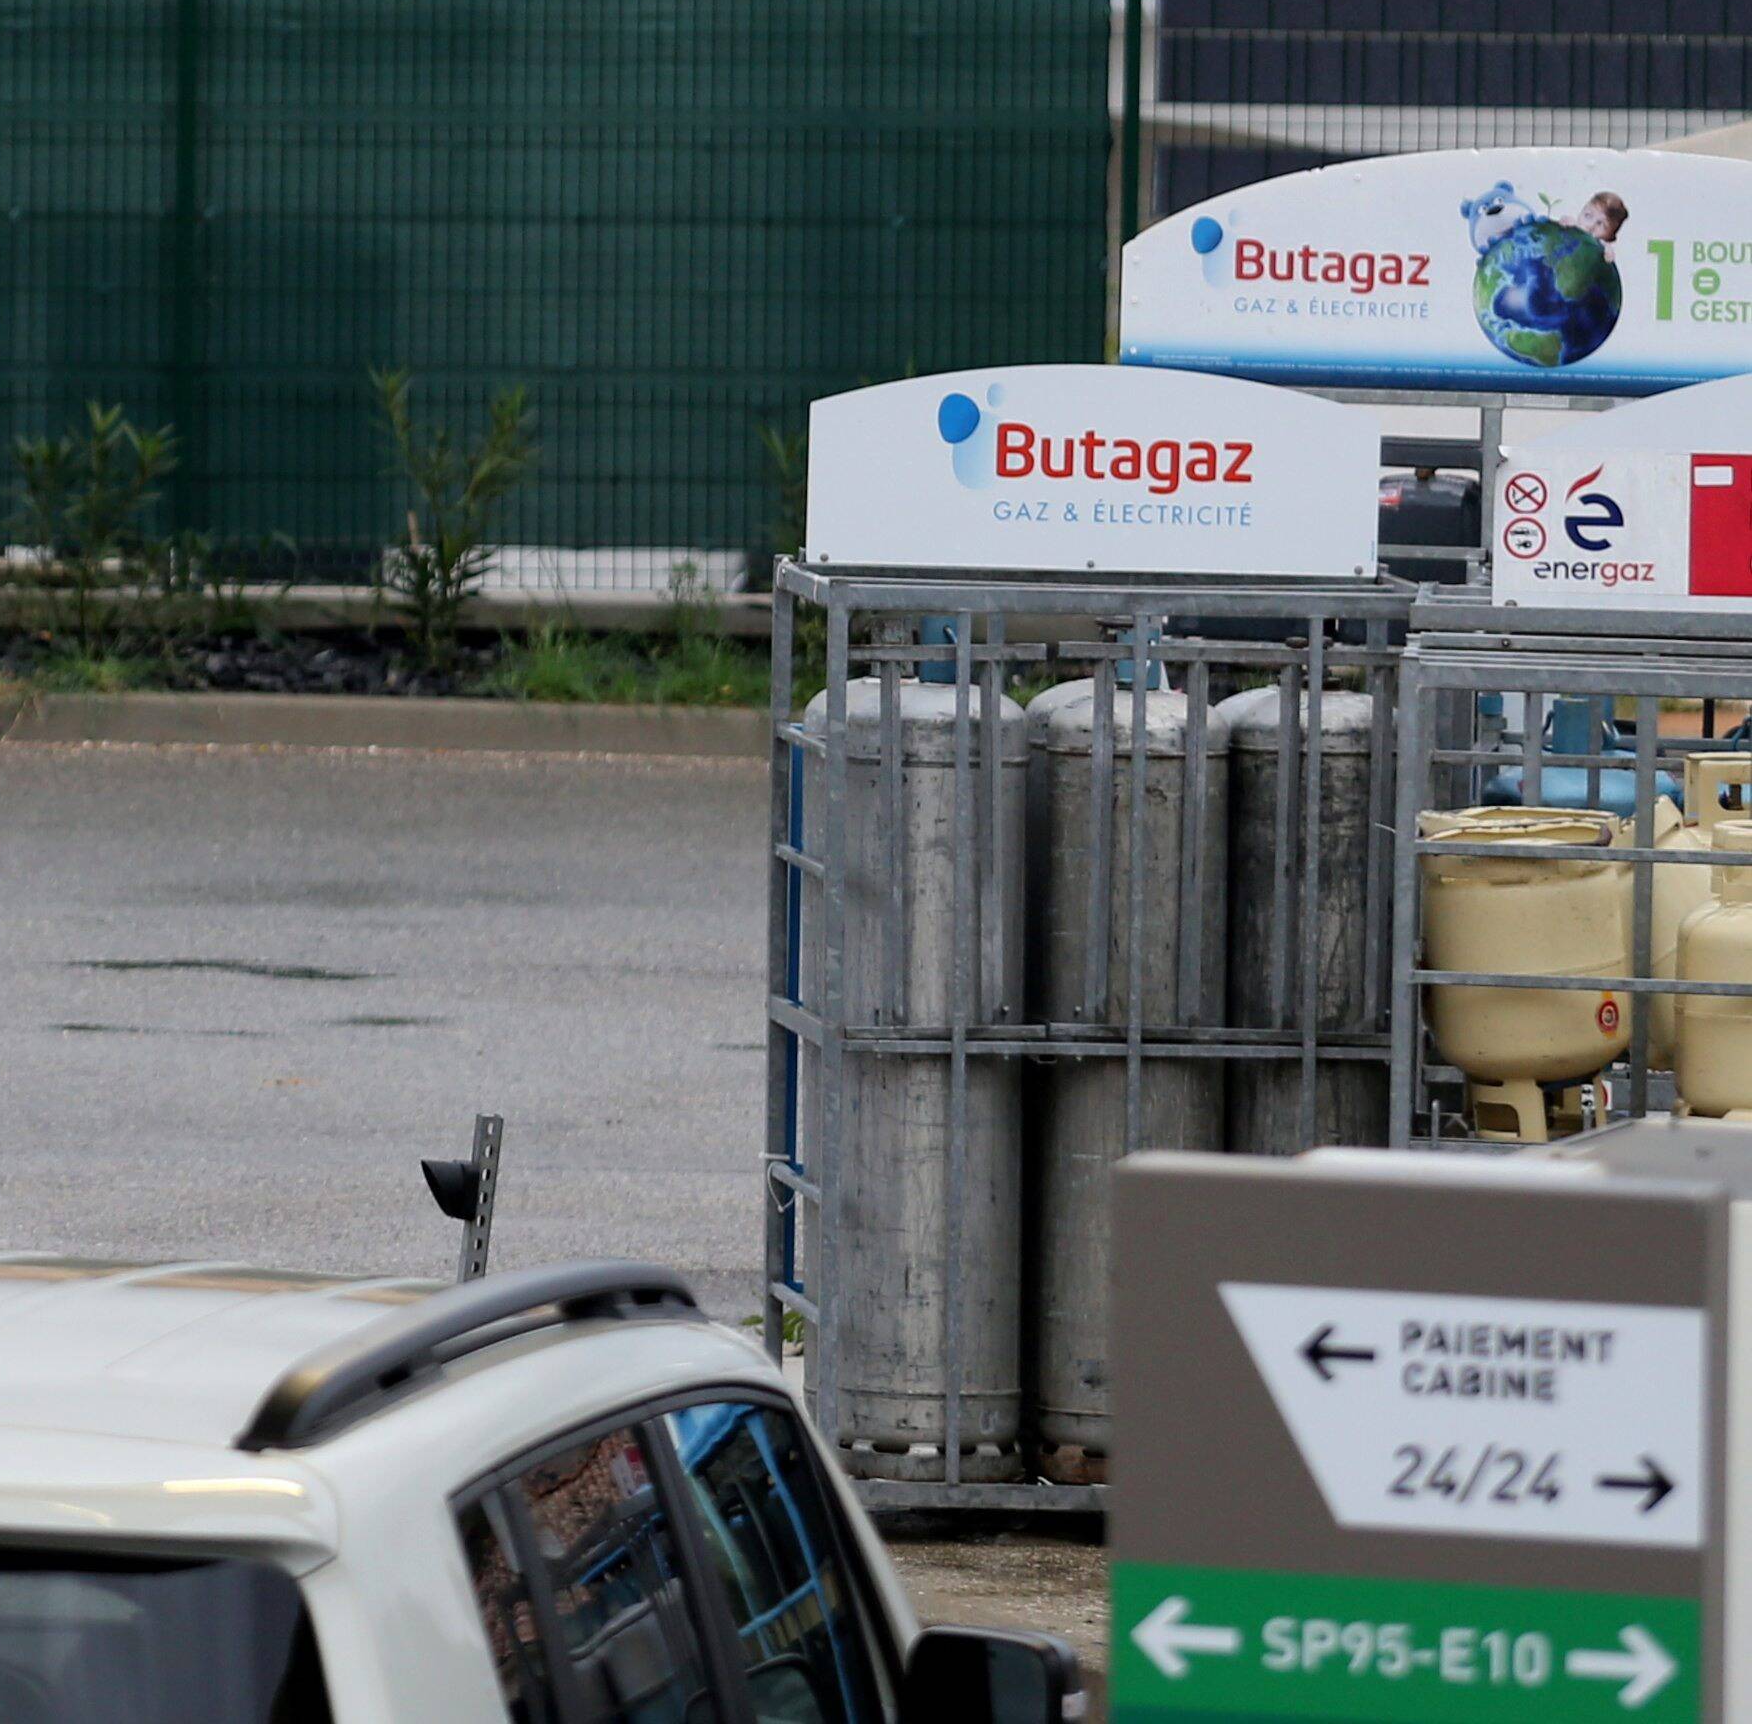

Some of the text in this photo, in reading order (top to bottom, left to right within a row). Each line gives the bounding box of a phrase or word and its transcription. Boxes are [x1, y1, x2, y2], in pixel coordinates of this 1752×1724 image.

[1235, 238, 1430, 294] Butagaz
[1648, 240, 1674, 320] 1
[1234, 297, 1430, 318] GAZ & ÉLECTRICITÉ
[996, 423, 1253, 494] Butagaz
[993, 499, 1251, 526] GAZ & ÉLECTRICITÉ
[1534, 560, 1656, 587] energaz
[1401, 1323, 1613, 1362] PAIEMENT
[1402, 1362, 1556, 1402] CABINE
[1389, 1444, 1560, 1504] 24/24
[1261, 1617, 1553, 1687] SP95-E10
